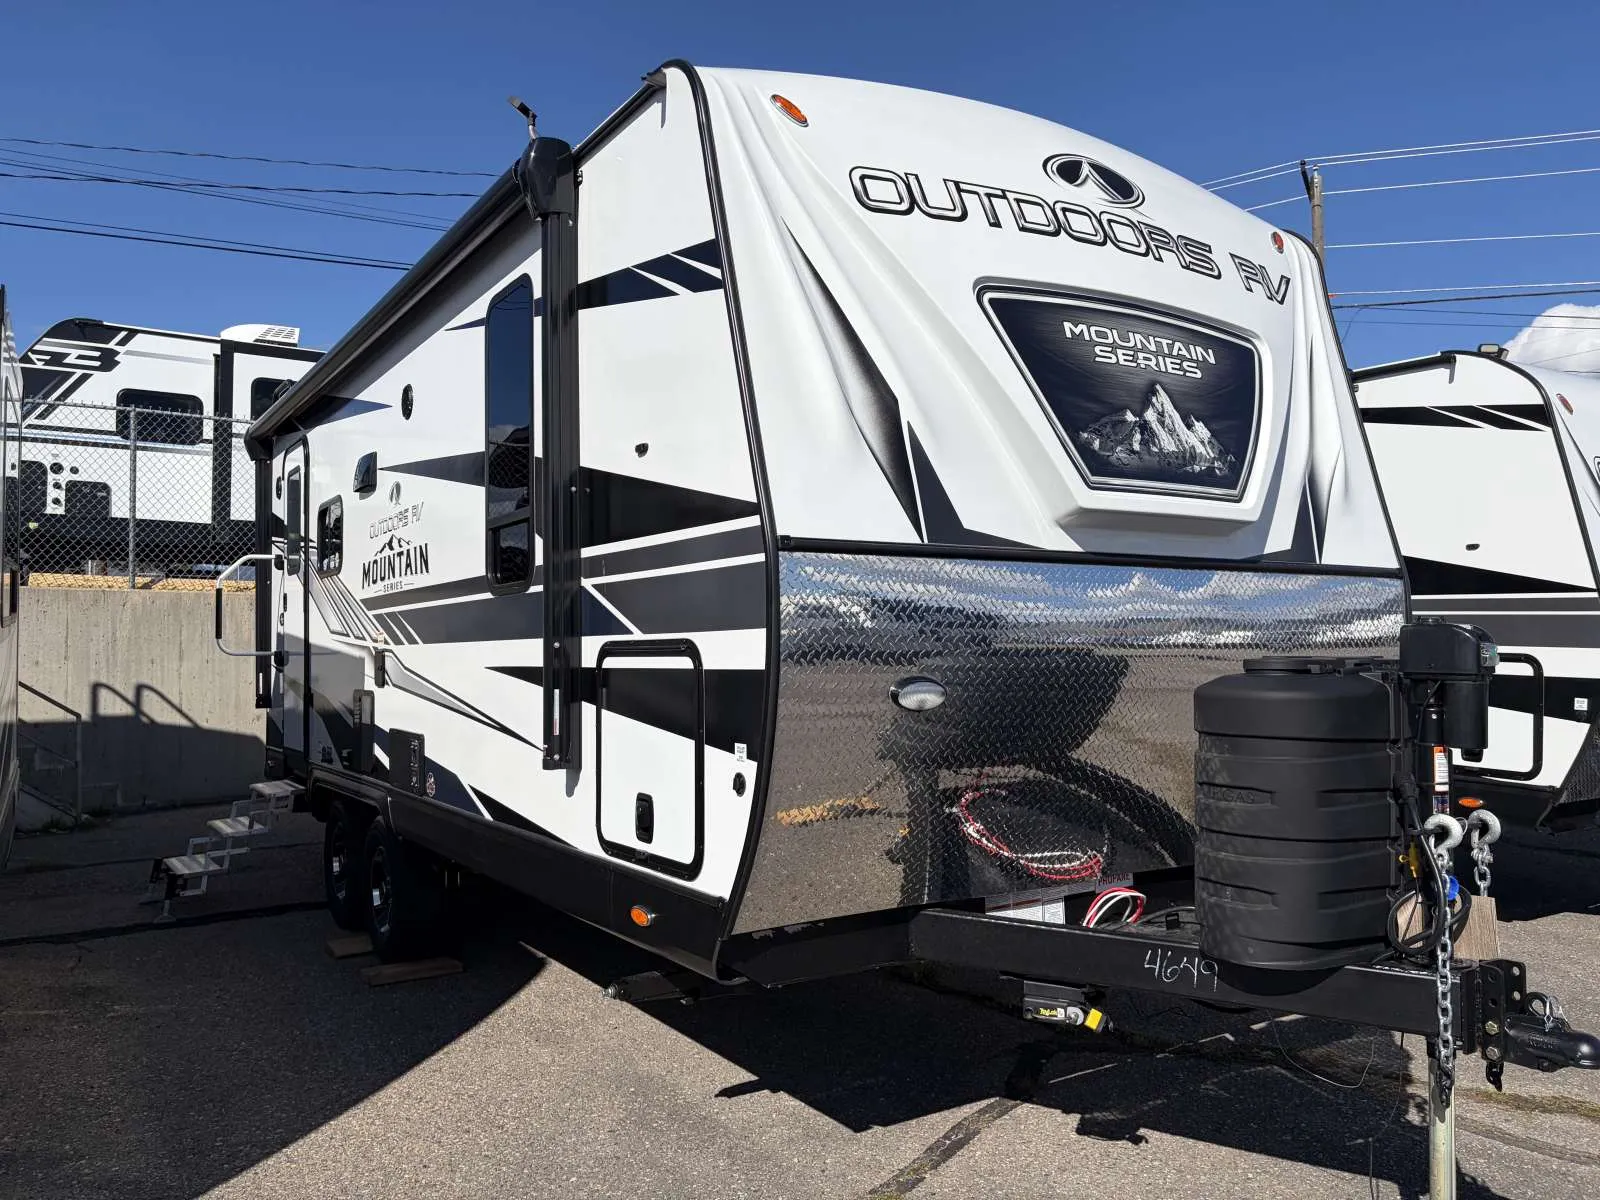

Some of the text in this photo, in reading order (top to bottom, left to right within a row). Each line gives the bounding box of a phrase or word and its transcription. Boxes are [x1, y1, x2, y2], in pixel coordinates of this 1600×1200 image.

[849, 165, 1291, 305] OUTDOORS RV
[1063, 321, 1217, 366] MOUNTAIN
[1093, 345, 1203, 379] SERIES
[362, 543, 430, 590] MOUNTAIN
[383, 581, 403, 593] SERIES
[1144, 948, 1218, 992] 4649
